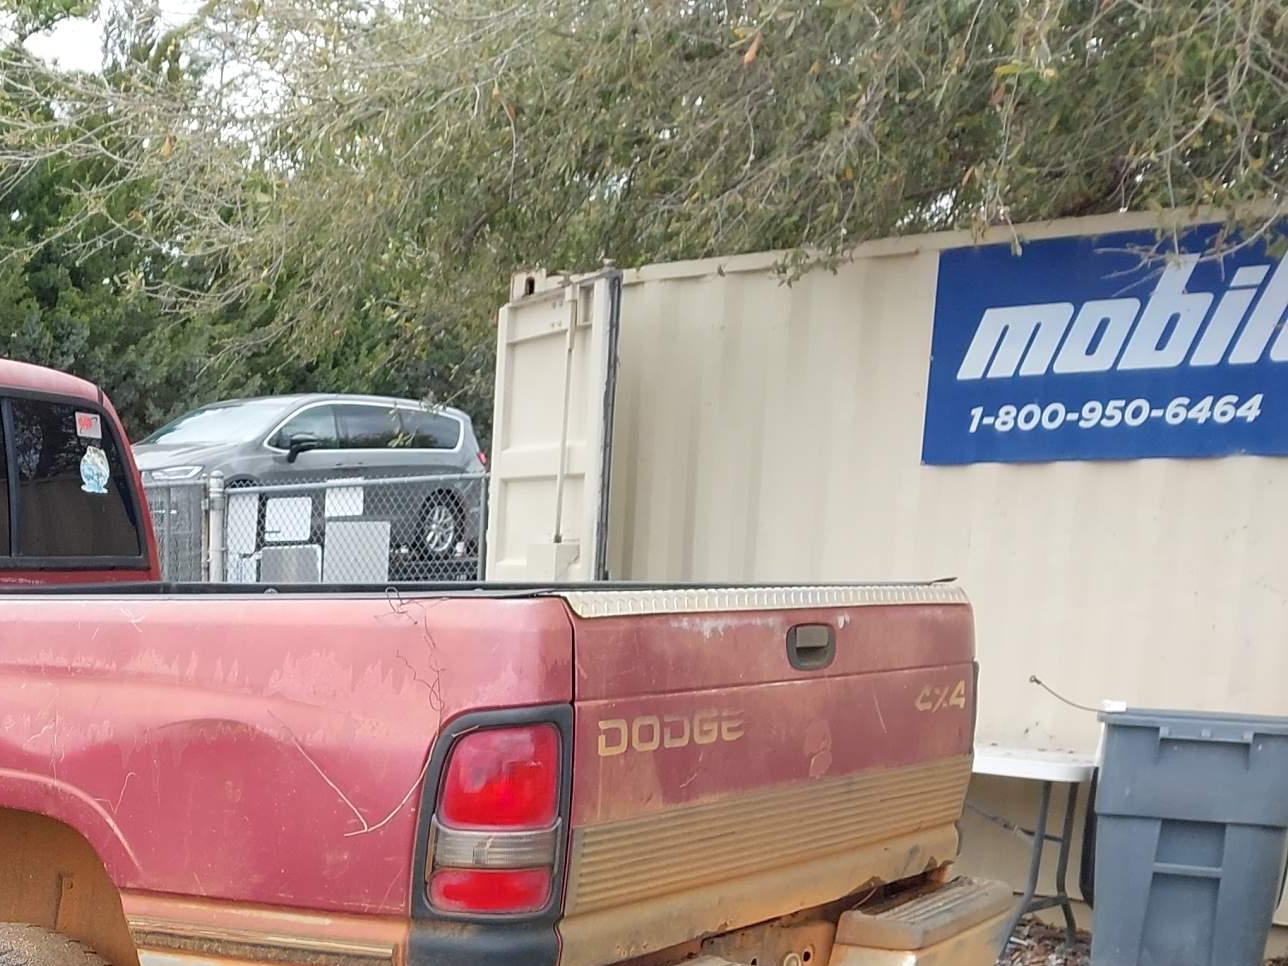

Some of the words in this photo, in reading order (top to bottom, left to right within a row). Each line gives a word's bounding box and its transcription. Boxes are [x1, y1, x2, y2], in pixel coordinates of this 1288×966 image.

[956, 249, 1288, 381] mobil
[969, 394, 1264, 433] 1-800-950-6464
[598, 704, 745, 758] DODGE
